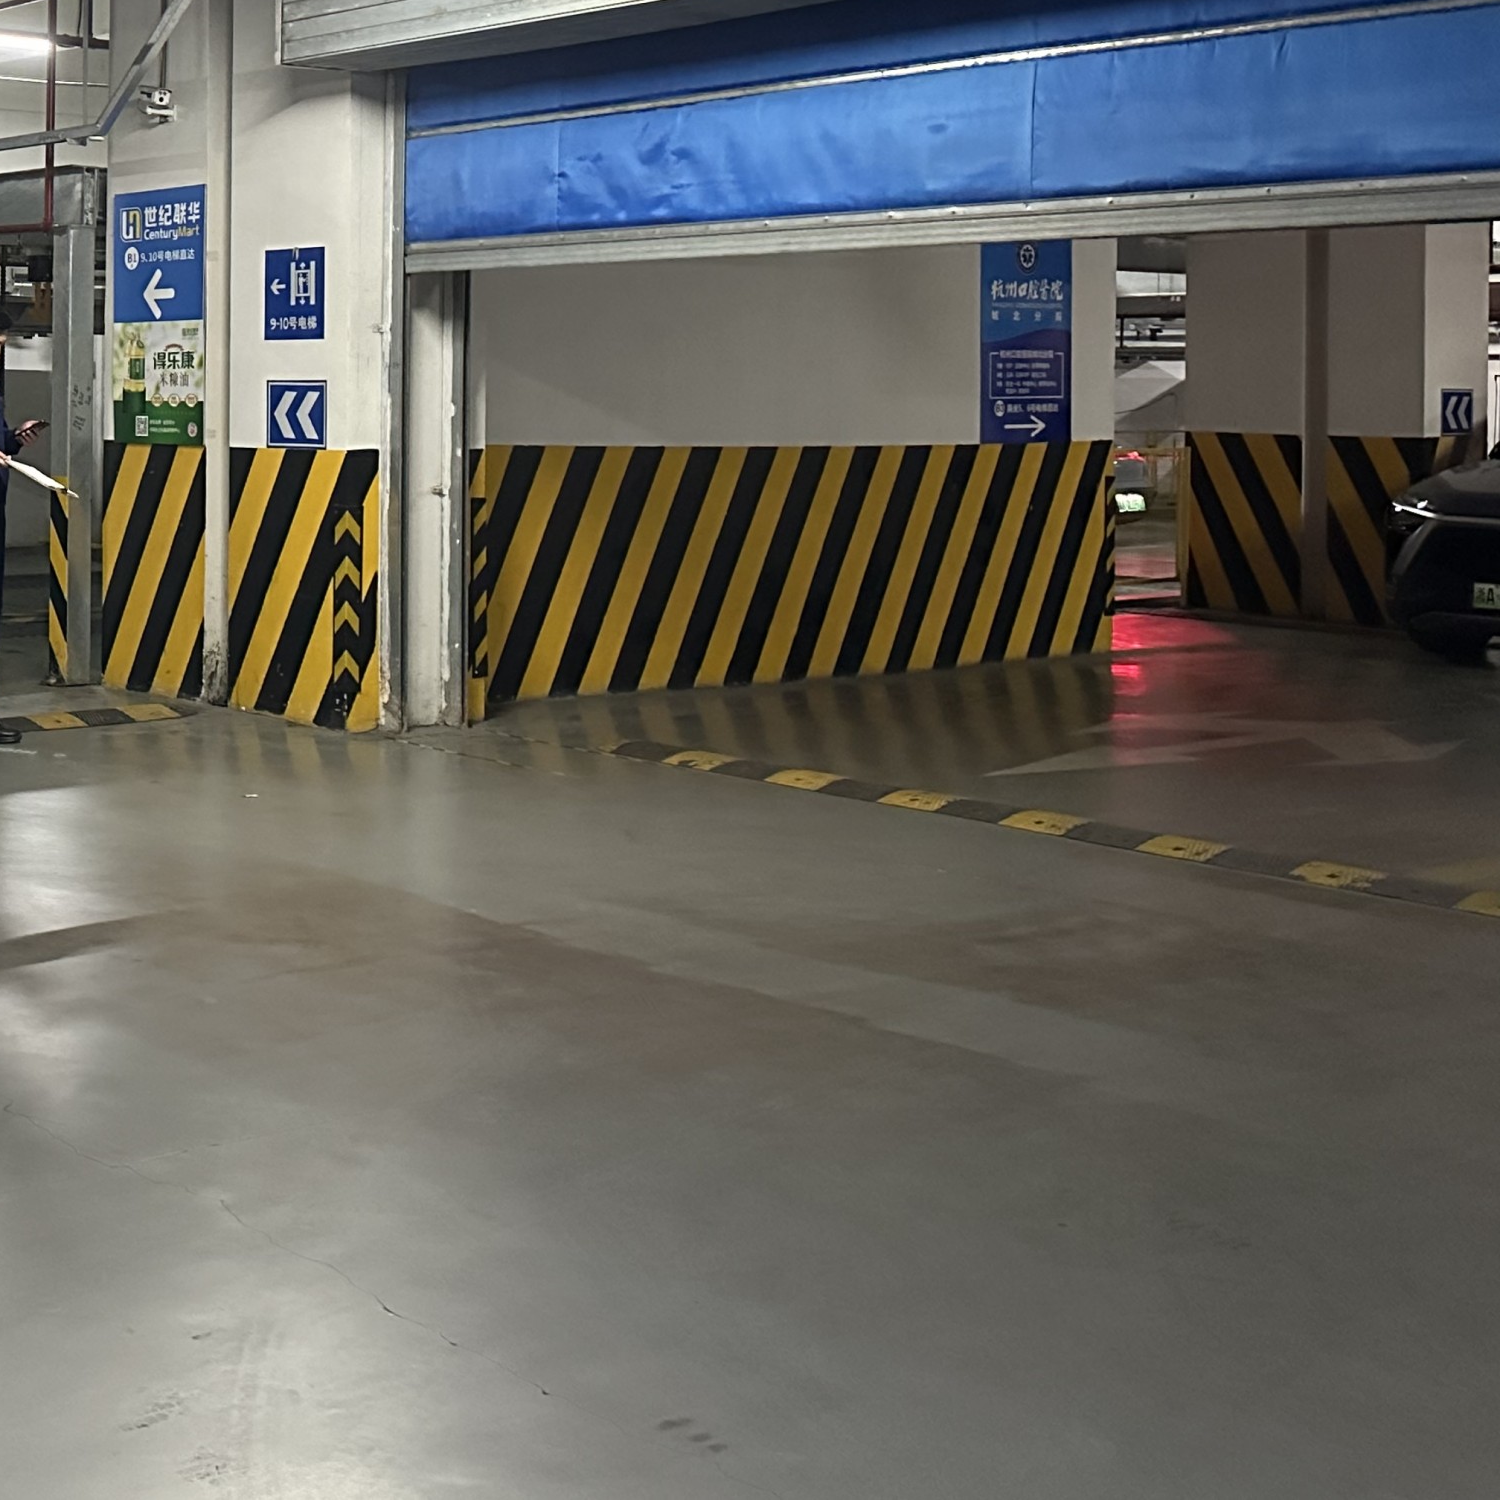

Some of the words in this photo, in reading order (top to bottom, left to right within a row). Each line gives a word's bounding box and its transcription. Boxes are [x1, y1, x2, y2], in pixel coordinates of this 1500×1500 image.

[144, 201, 200, 227] 世纪联华
[144, 224, 200, 240] CenturyMart
[270, 315, 317, 330] 9-10号电梯
[153, 351, 195, 370] 得乐康
